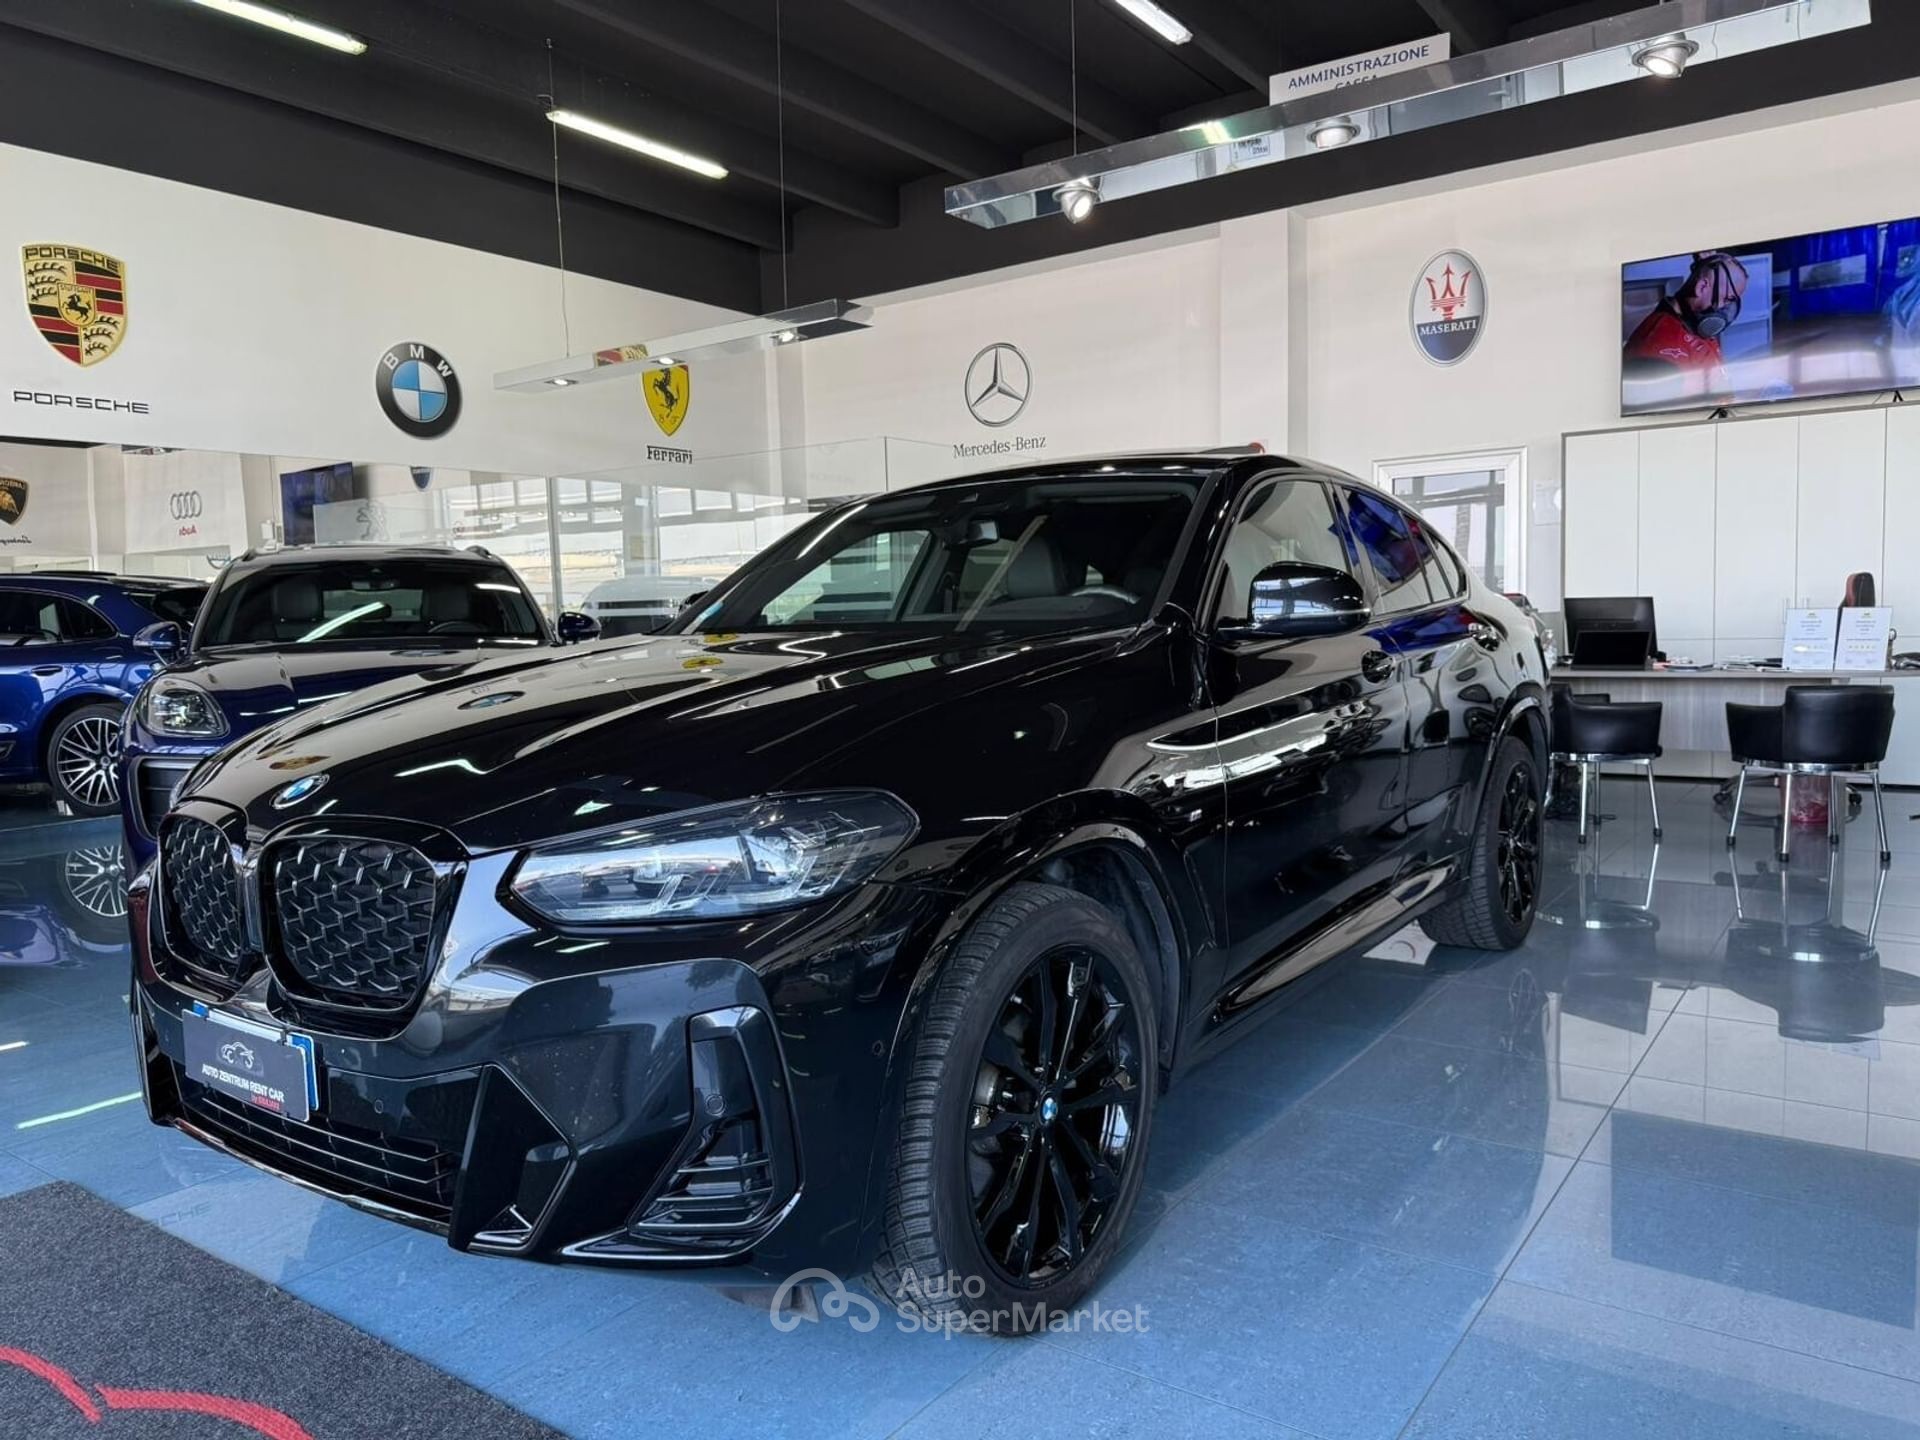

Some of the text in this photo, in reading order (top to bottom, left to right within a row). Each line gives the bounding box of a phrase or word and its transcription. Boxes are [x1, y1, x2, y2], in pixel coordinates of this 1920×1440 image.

[1288, 44, 1430, 89] AMMINISTRAZIONE
[25, 247, 120, 273] PORSCHE
[1420, 319, 1477, 336] MASERATI
[383, 344, 453, 377] BMW
[13, 390, 149, 414] PORSCHE
[646, 445, 693, 464] Ferrari
[953, 436, 1046, 459] Mercedes-Benz
[219, 1069, 250, 1091] ZENTRUM
[249, 1080, 269, 1097] RENT
[268, 1087, 286, 1103] CAR
